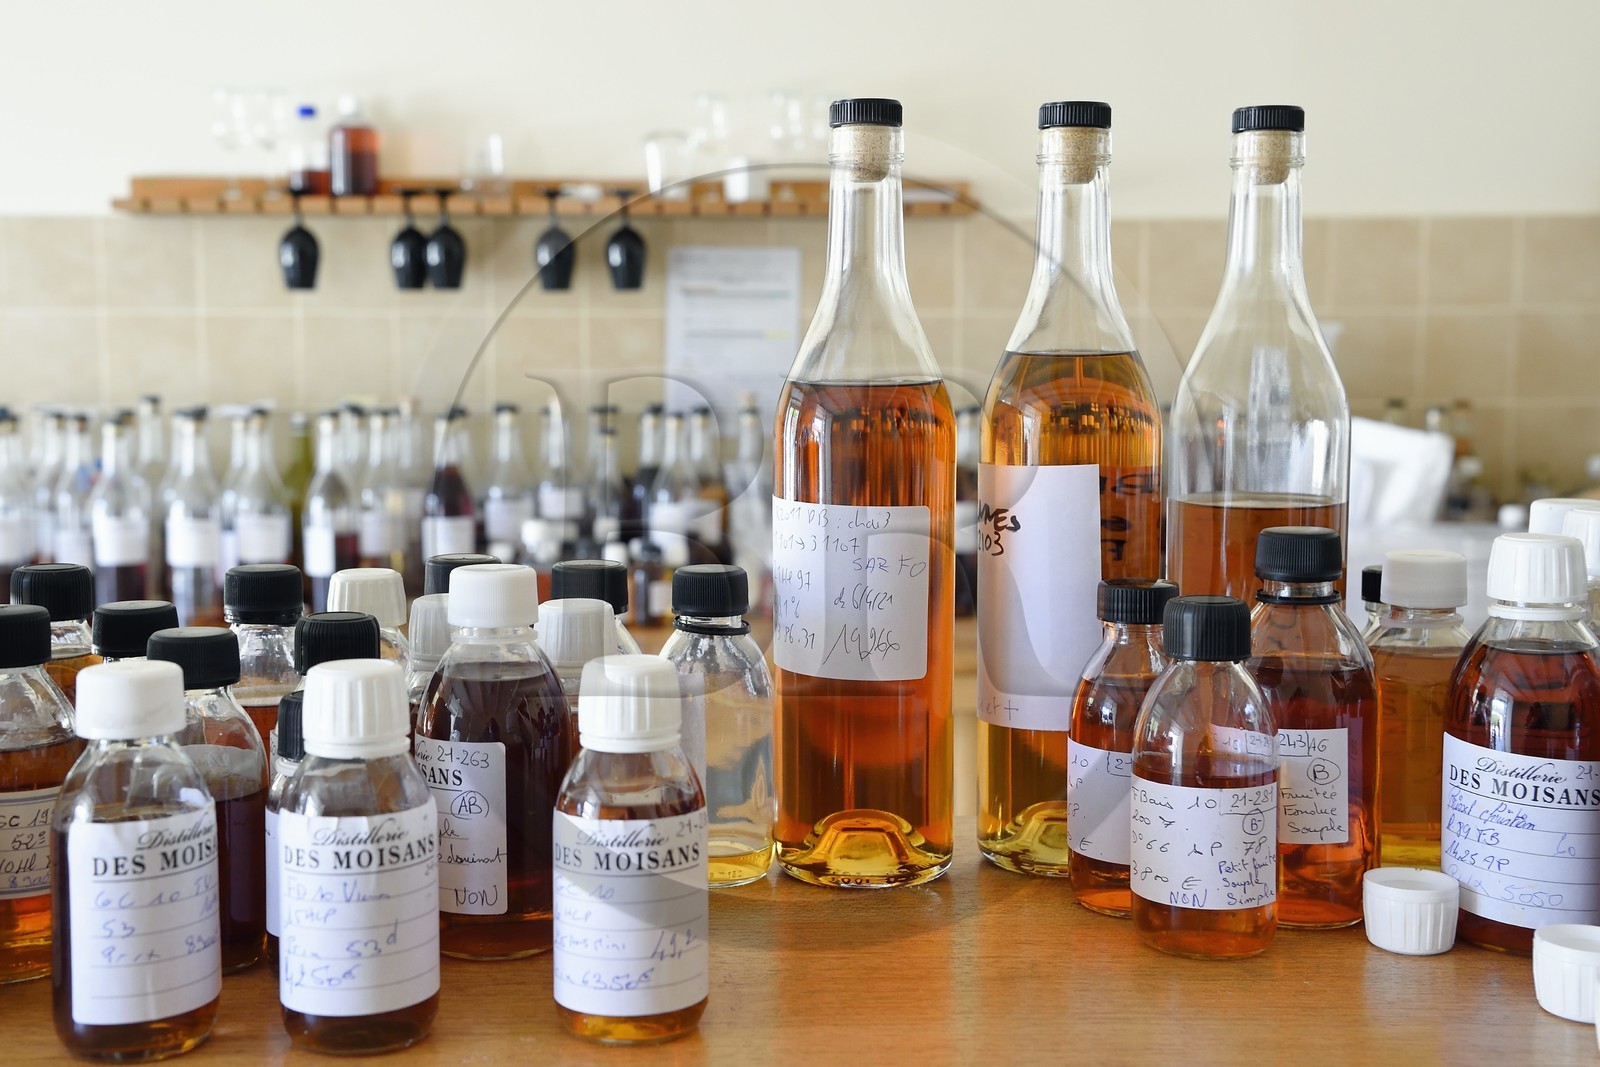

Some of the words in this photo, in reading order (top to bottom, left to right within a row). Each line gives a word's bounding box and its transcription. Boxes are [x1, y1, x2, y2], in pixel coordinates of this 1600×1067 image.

[1449, 764, 1482, 790] DES
[1490, 779, 1600, 808] MOISANS
[1475, 757, 1568, 785] Distillerie
[312, 817, 409, 847] Distillerie
[576, 823, 670, 848] Distillerie
[92, 854, 147, 877] DES
[159, 838, 217, 872] MOIS
[284, 845, 321, 869] DES
[332, 833, 435, 870] MOISANS
[555, 842, 583, 868] DES
[594, 842, 701, 871] MOISANS
